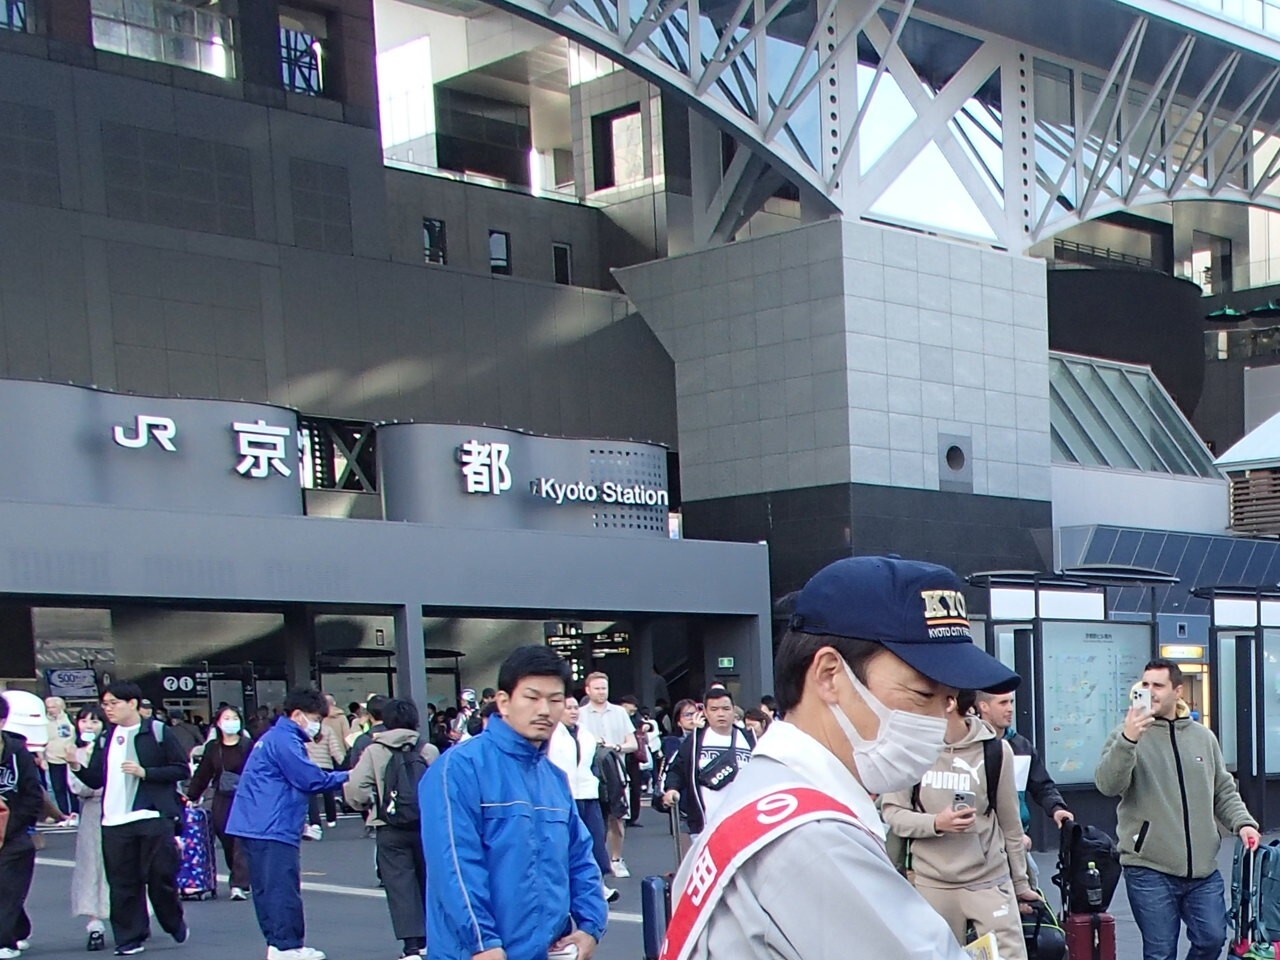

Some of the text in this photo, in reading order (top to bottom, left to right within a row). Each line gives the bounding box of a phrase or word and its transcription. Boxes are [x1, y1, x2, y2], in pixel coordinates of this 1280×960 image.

[113, 414, 513, 495] JR 京 都
[540, 477, 669, 505] Kyoto Station
[928, 627, 951, 638] KYOTO
[711, 765, 734, 785] BOSS
[921, 770, 971, 791] PUMA
